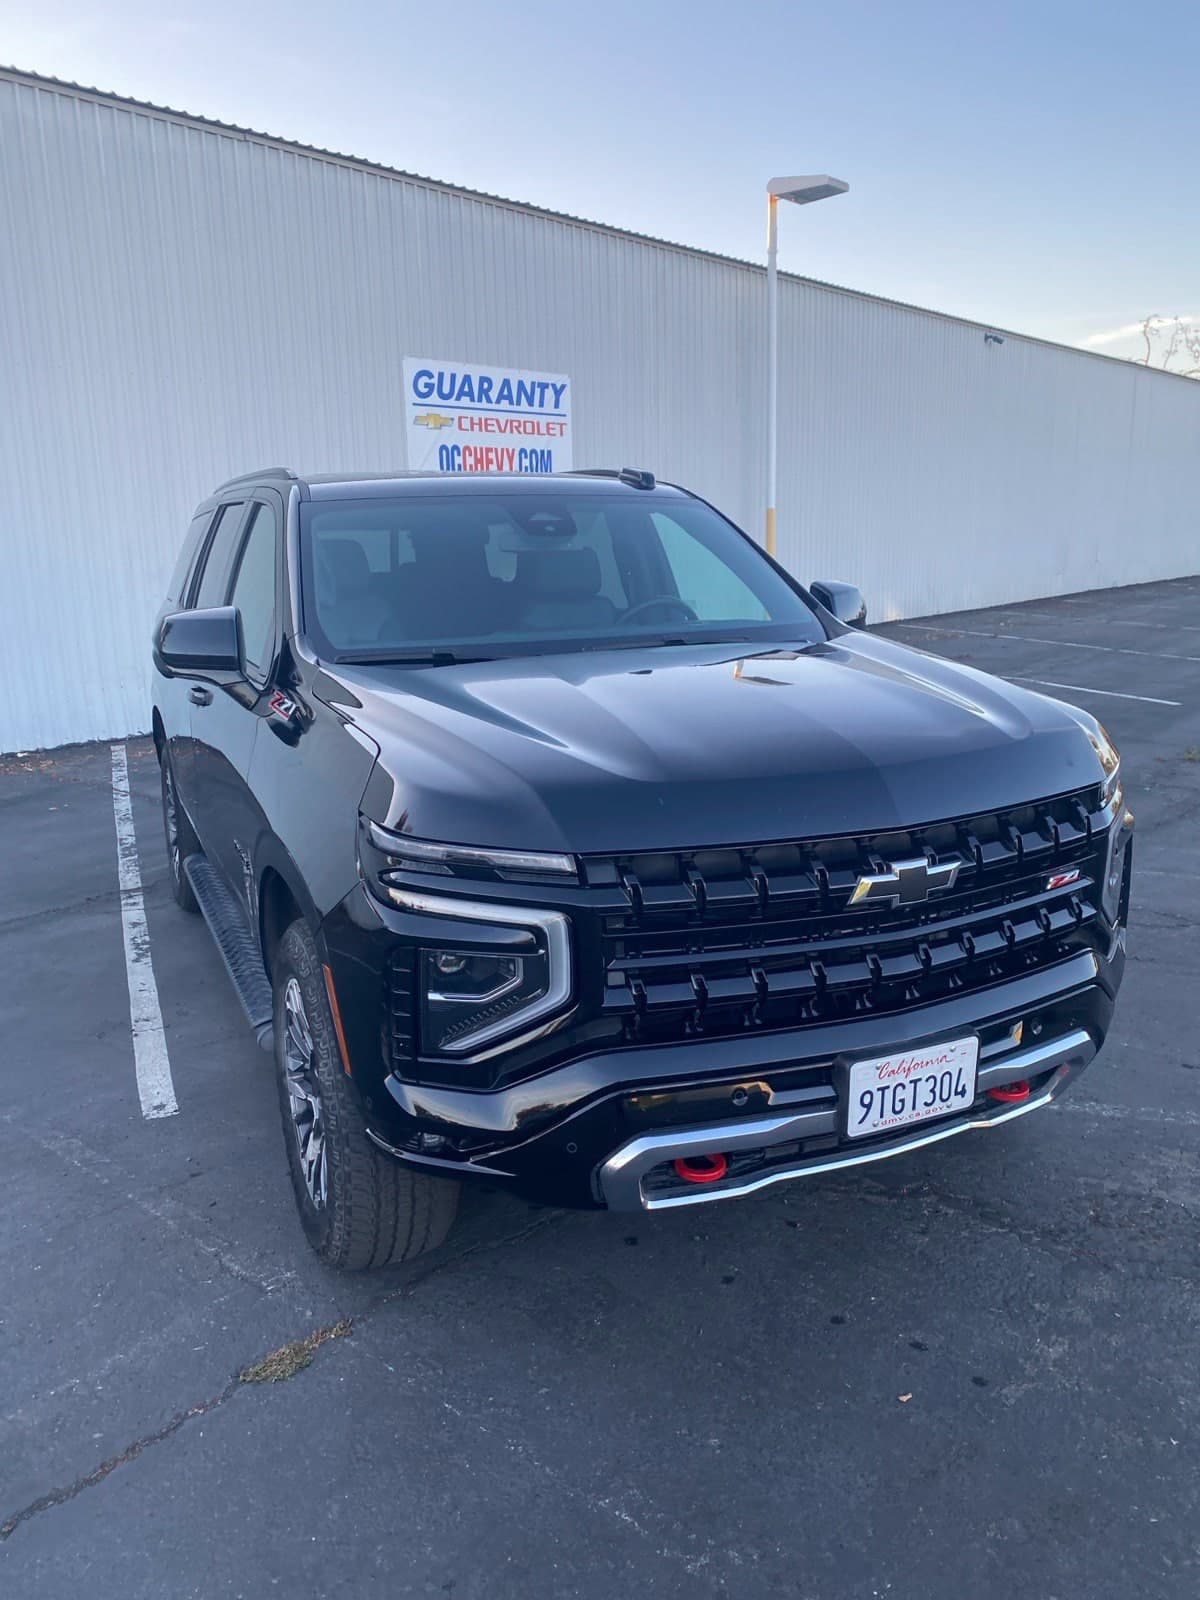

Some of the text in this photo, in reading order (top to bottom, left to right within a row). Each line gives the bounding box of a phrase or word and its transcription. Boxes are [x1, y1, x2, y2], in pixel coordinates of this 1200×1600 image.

[412, 369, 567, 409] GUARANTY
[458, 416, 567, 436] CHEVROLET
[439, 444, 552, 472] OCCHEVYCOM
[269, 690, 296, 720] Z71
[878, 1054, 955, 1080] California
[857, 1067, 967, 1125] 9TGT304
[880, 1105, 945, 1127] dmv.ca.gov
